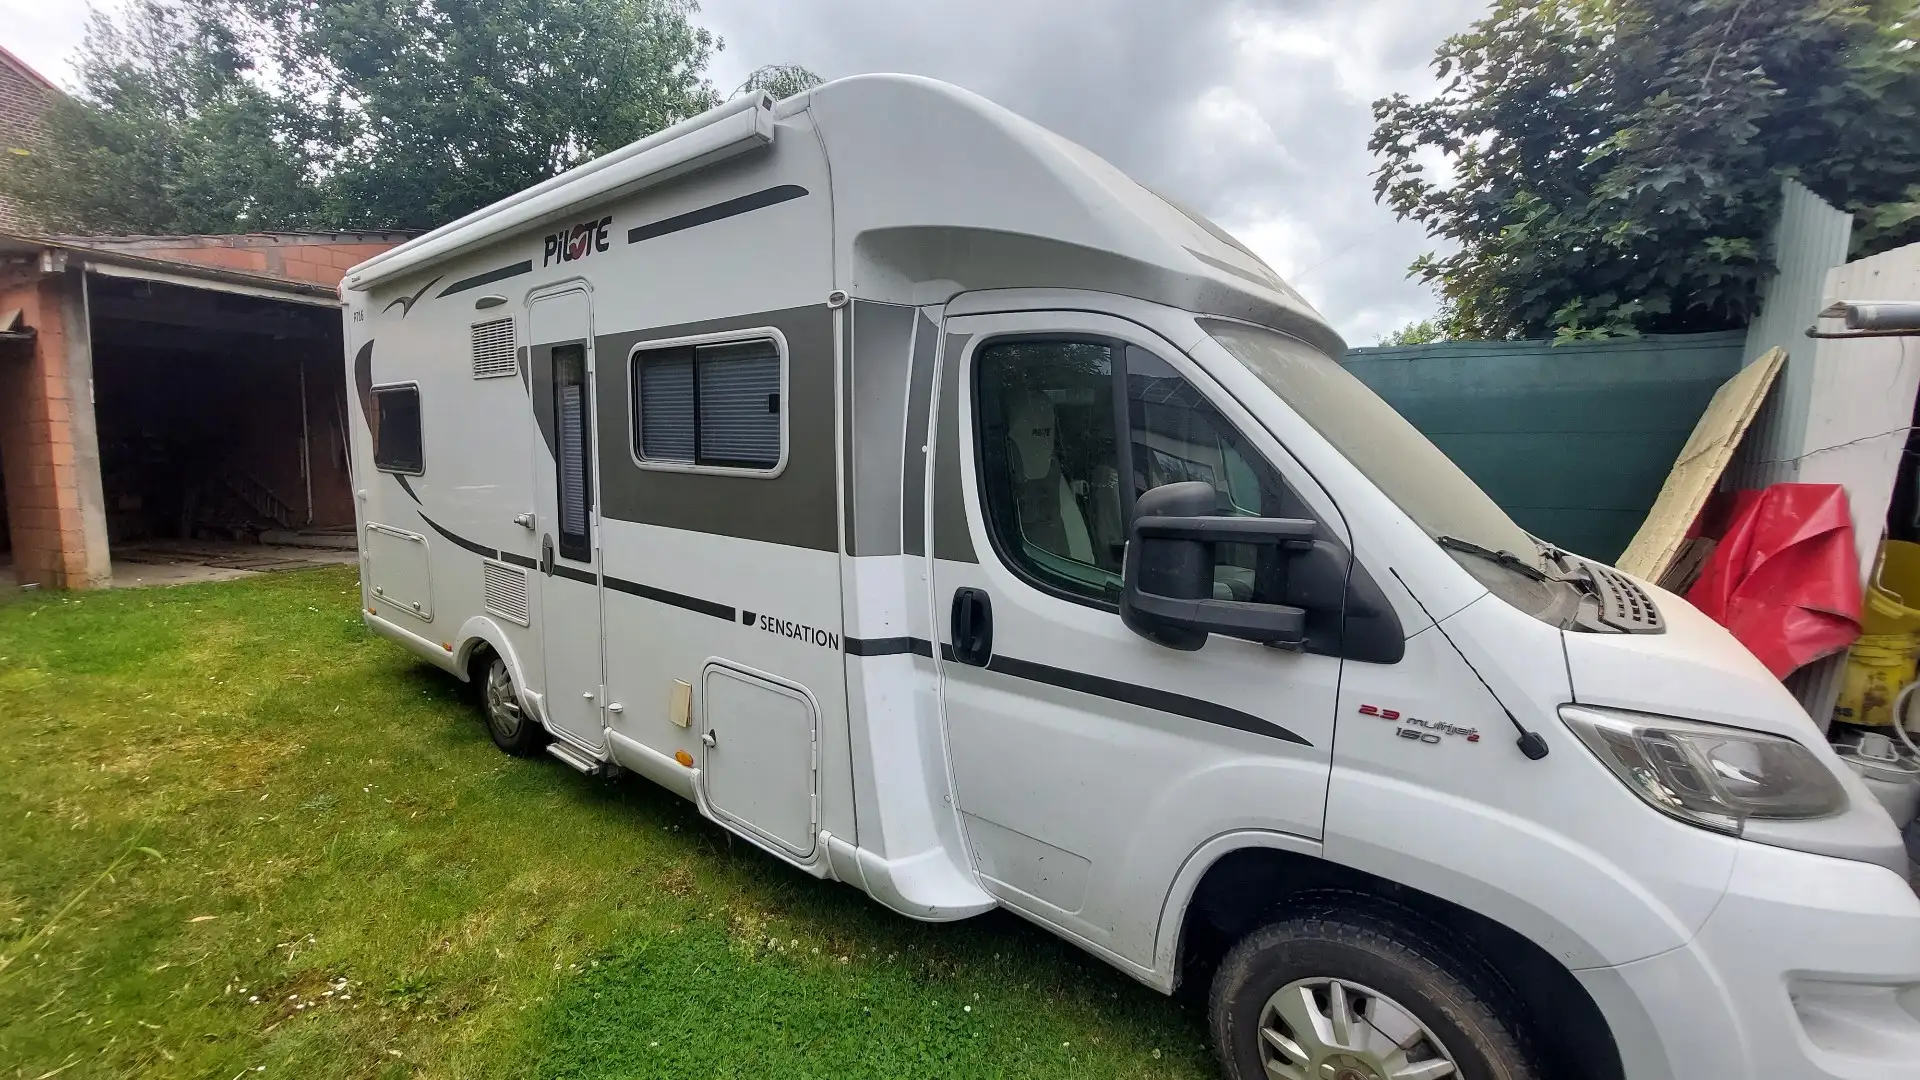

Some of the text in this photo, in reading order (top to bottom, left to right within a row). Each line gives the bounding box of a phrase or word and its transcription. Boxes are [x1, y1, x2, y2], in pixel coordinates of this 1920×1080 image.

[760, 614, 839, 651] SENSATION
[1358, 704, 1400, 720] 2.3
[1395, 726, 1441, 744] 150
